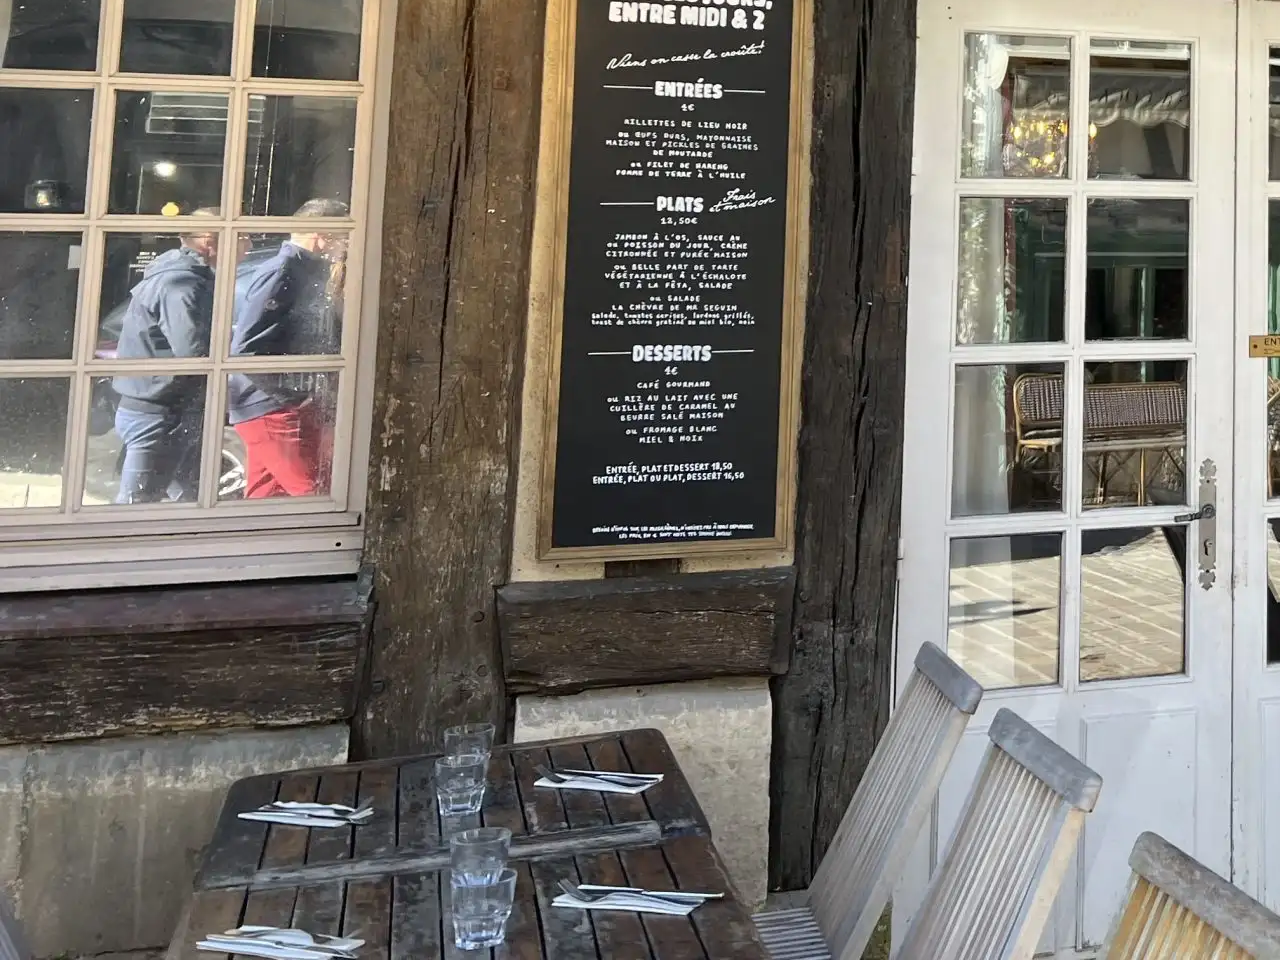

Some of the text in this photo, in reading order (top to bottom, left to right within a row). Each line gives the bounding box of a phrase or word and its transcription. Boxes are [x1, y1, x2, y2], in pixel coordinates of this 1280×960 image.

[609, 2, 765, 30] ENTRE MIDI & 2
[606, 53, 647, 69] Viens
[671, 54, 701, 62] casse
[703, 49, 718, 59] la
[655, 77, 723, 99] ENTRÉES
[681, 103, 695, 111] 4€
[624, 118, 747, 130] RILLETTES DE LIEU NOIR
[664, 132, 689, 141] DURS,
[696, 134, 752, 142] MAYONNAISE
[662, 141, 700, 149] PICKLES
[721, 142, 758, 150] GRAINES
[669, 150, 713, 158] MOUTARDE
[695, 162, 728, 170] HARENG
[697, 169, 703, 178] À
[709, 171, 746, 179] L'HUILE
[723, 188, 756, 202] Frais
[656, 195, 704, 213] PLATS
[709, 197, 776, 212] et maison
[660, 217, 698, 226] 12,50€
[653, 232, 659, 240] À
[664, 233, 689, 242] L'OS,
[686, 242, 713, 251] JOUR,
[720, 240, 747, 249] CRÈME
[605, 249, 657, 257] CITRONNÉE
[680, 250, 709, 258] PURÉE
[604, 270, 673, 280] VÉGÉTARIENNE
[691, 271, 747, 280] L'ÉCHALOTE
[619, 281, 630, 289] ET
[636, 280, 642, 289] À
[665, 280, 691, 291] FÊTA,
[629, 302, 664, 311] CHÈVRE
[632, 344, 712, 362] DESSERTS
[664, 366, 678, 376] 4€
[637, 379, 711, 389] CAFÉ GOURMAND
[665, 394, 688, 402] LAIT
[609, 403, 655, 412] CUILLÈRE
[679, 403, 718, 411] CARAMEL
[620, 411, 724, 422] BEURRE SALÉ MAISON
[643, 426, 683, 434] FROMAGE
[689, 425, 718, 433] BLANC
[639, 436, 663, 444] MIEL
[606, 461, 733, 475] ENTRÉE, PLAT ET DESSERT 18,50
[592, 471, 745, 485] ENTRÉE, PLAT OU PLAT, DESSERT 16,50
